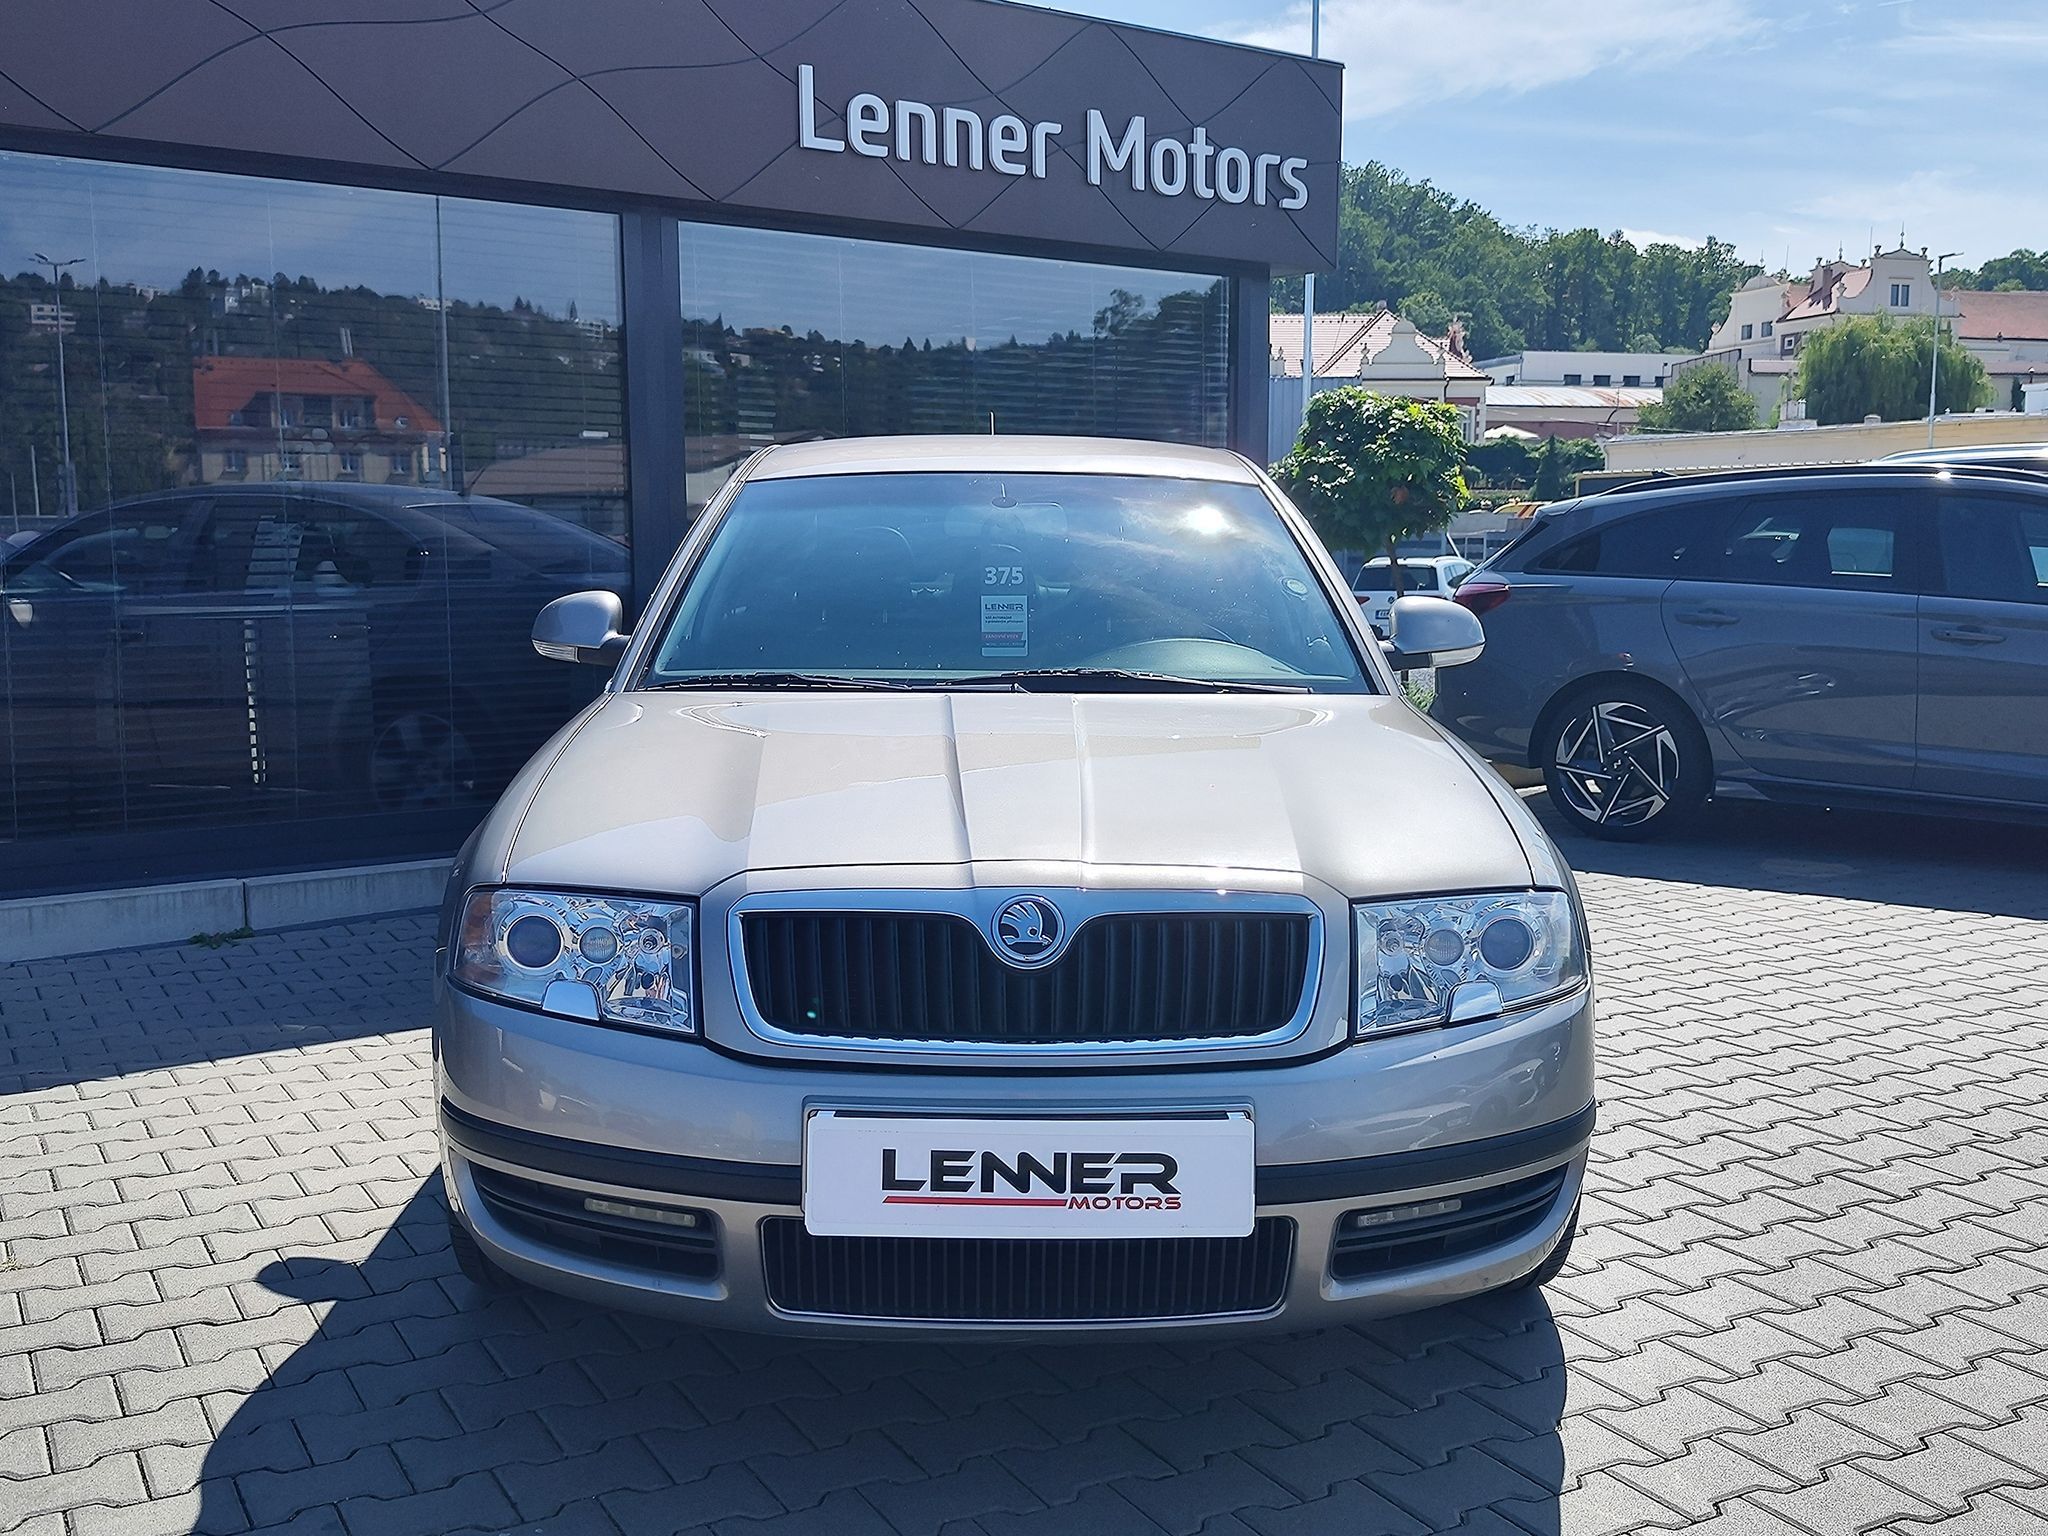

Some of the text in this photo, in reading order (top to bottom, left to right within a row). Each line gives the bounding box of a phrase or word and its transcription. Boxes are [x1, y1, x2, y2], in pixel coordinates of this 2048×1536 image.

[797, 63, 1310, 210] Lenner Motors
[984, 566, 1024, 585] 375
[984, 603, 1024, 611] LENNER
[881, 1148, 1180, 1195] LENNER
[1066, 1196, 1182, 1211] MOTORS
